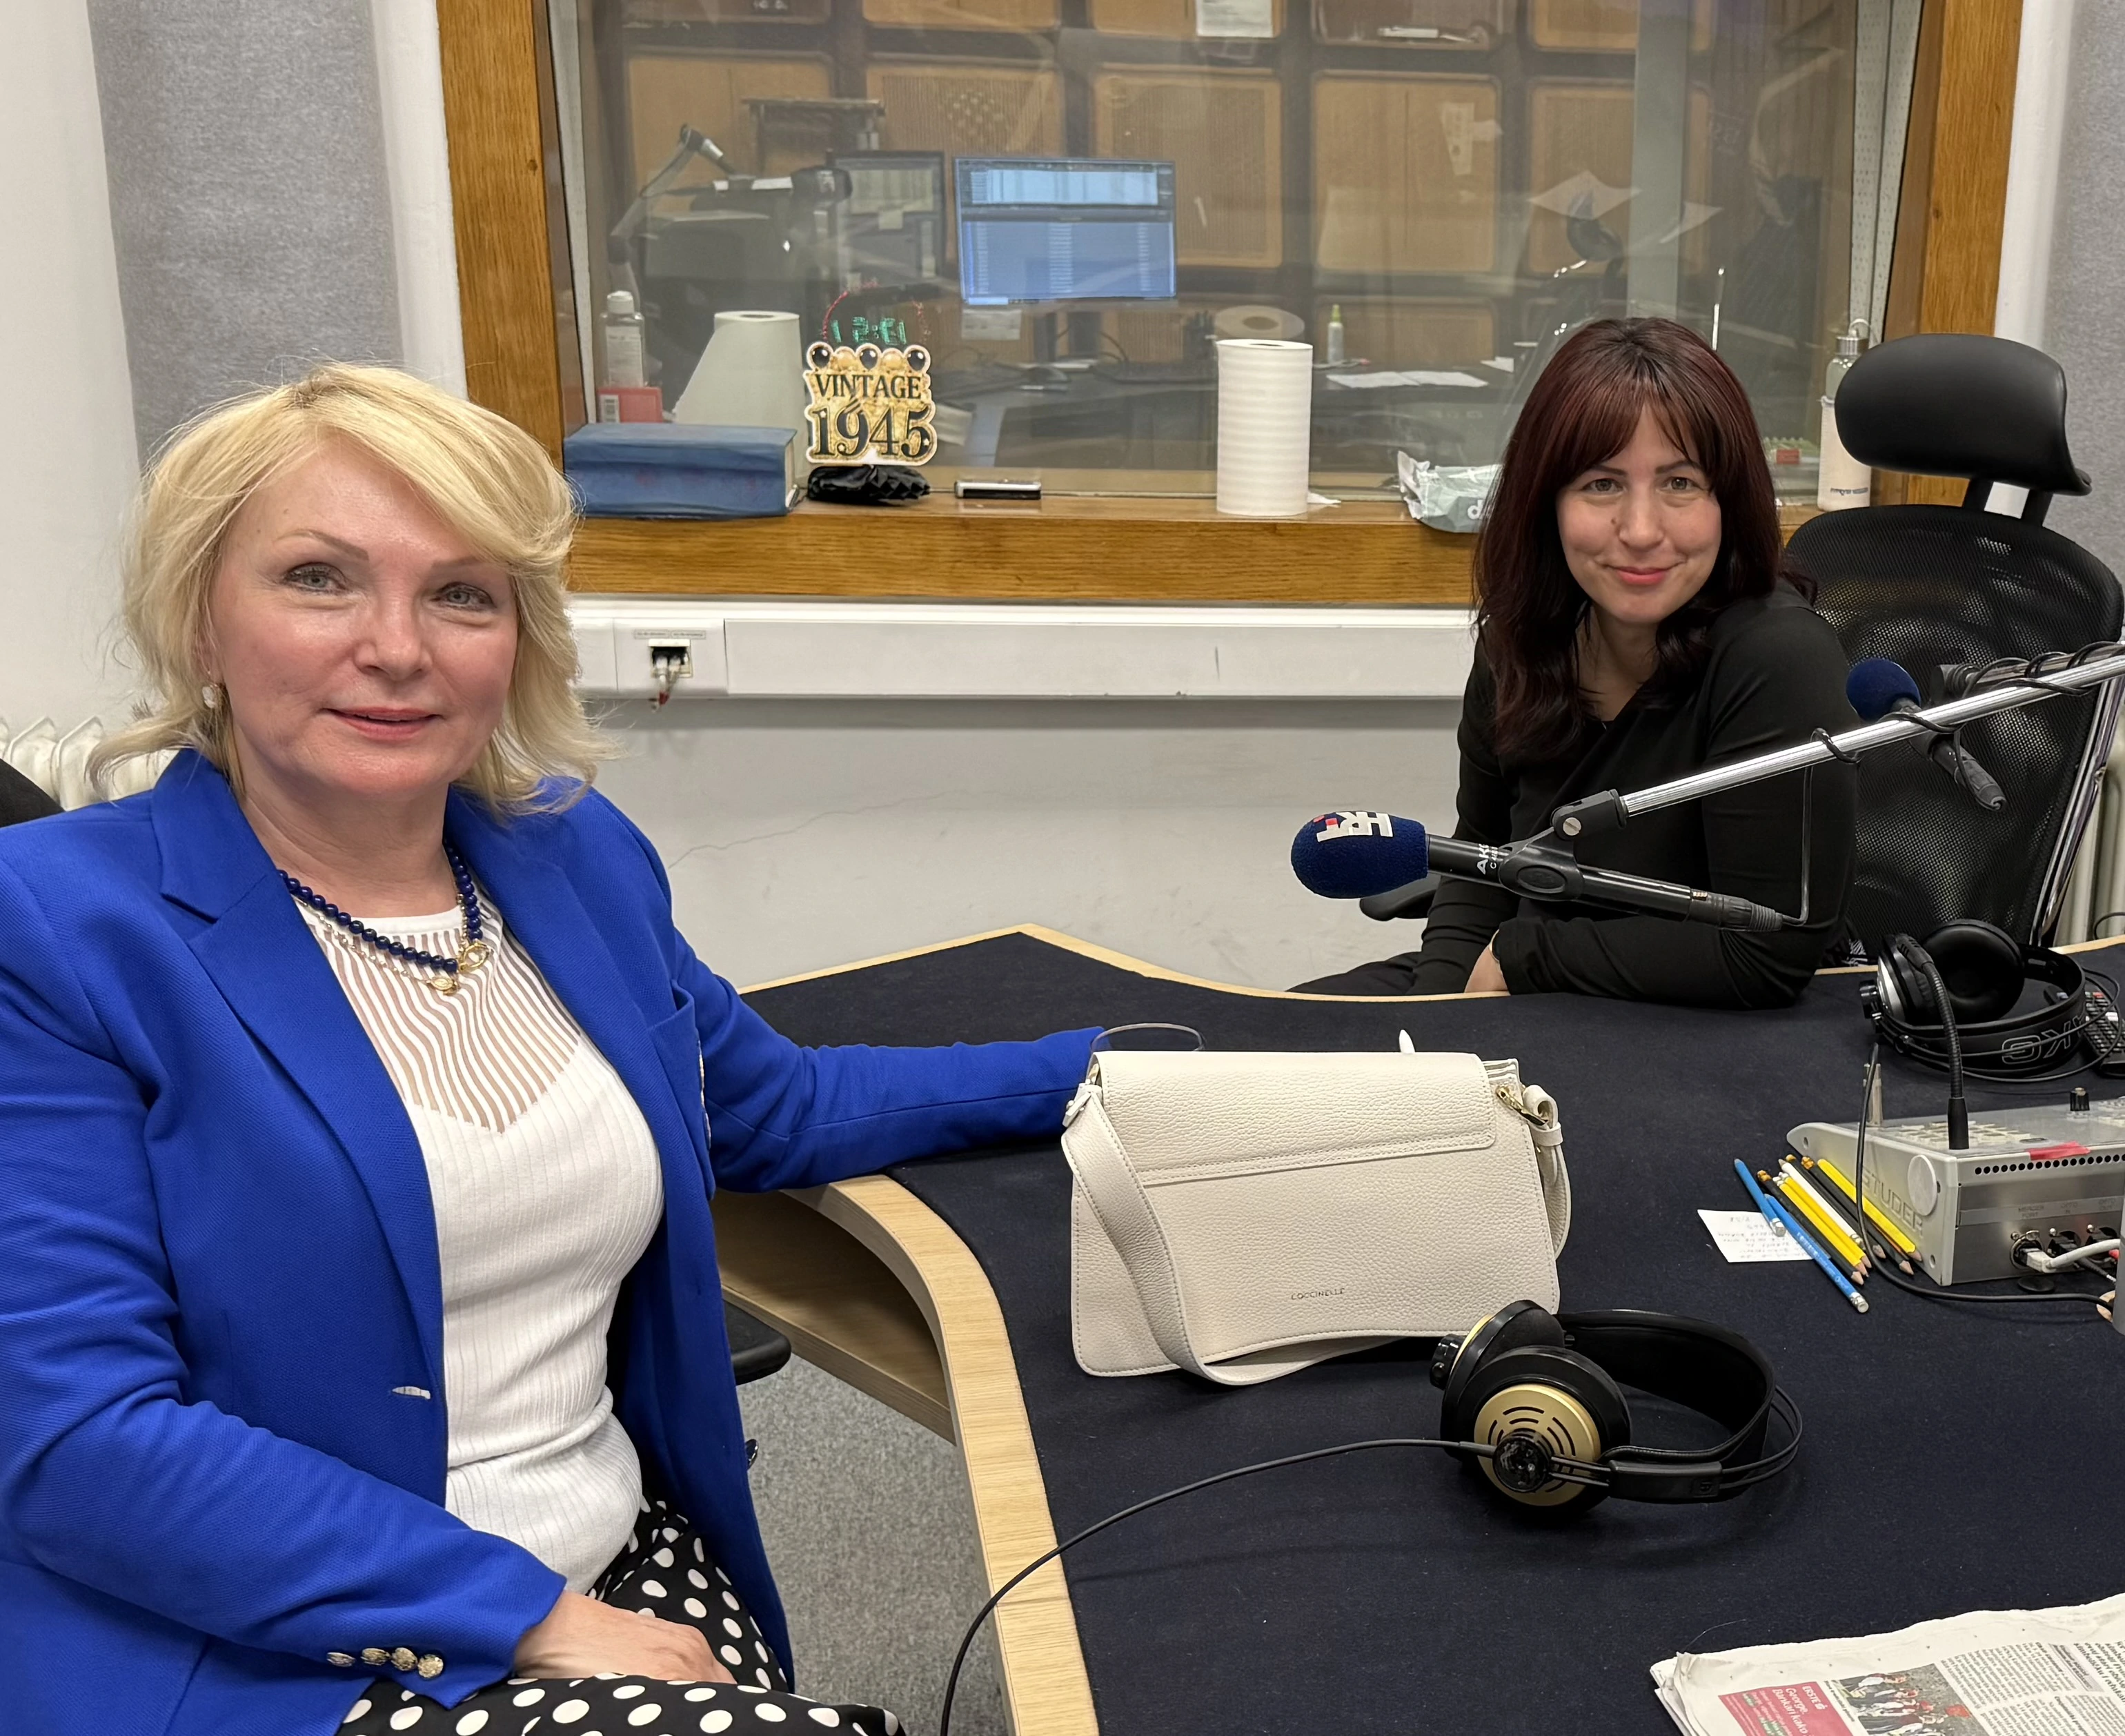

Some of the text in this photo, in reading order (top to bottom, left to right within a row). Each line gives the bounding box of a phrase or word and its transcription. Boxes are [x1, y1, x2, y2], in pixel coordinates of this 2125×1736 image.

[814, 373, 921, 400] VINTAGE
[812, 404, 931, 458] 1945
[1291, 1288, 1345, 1301] COCCINELLE
[1802, 1686, 1819, 1707] ERSTE
